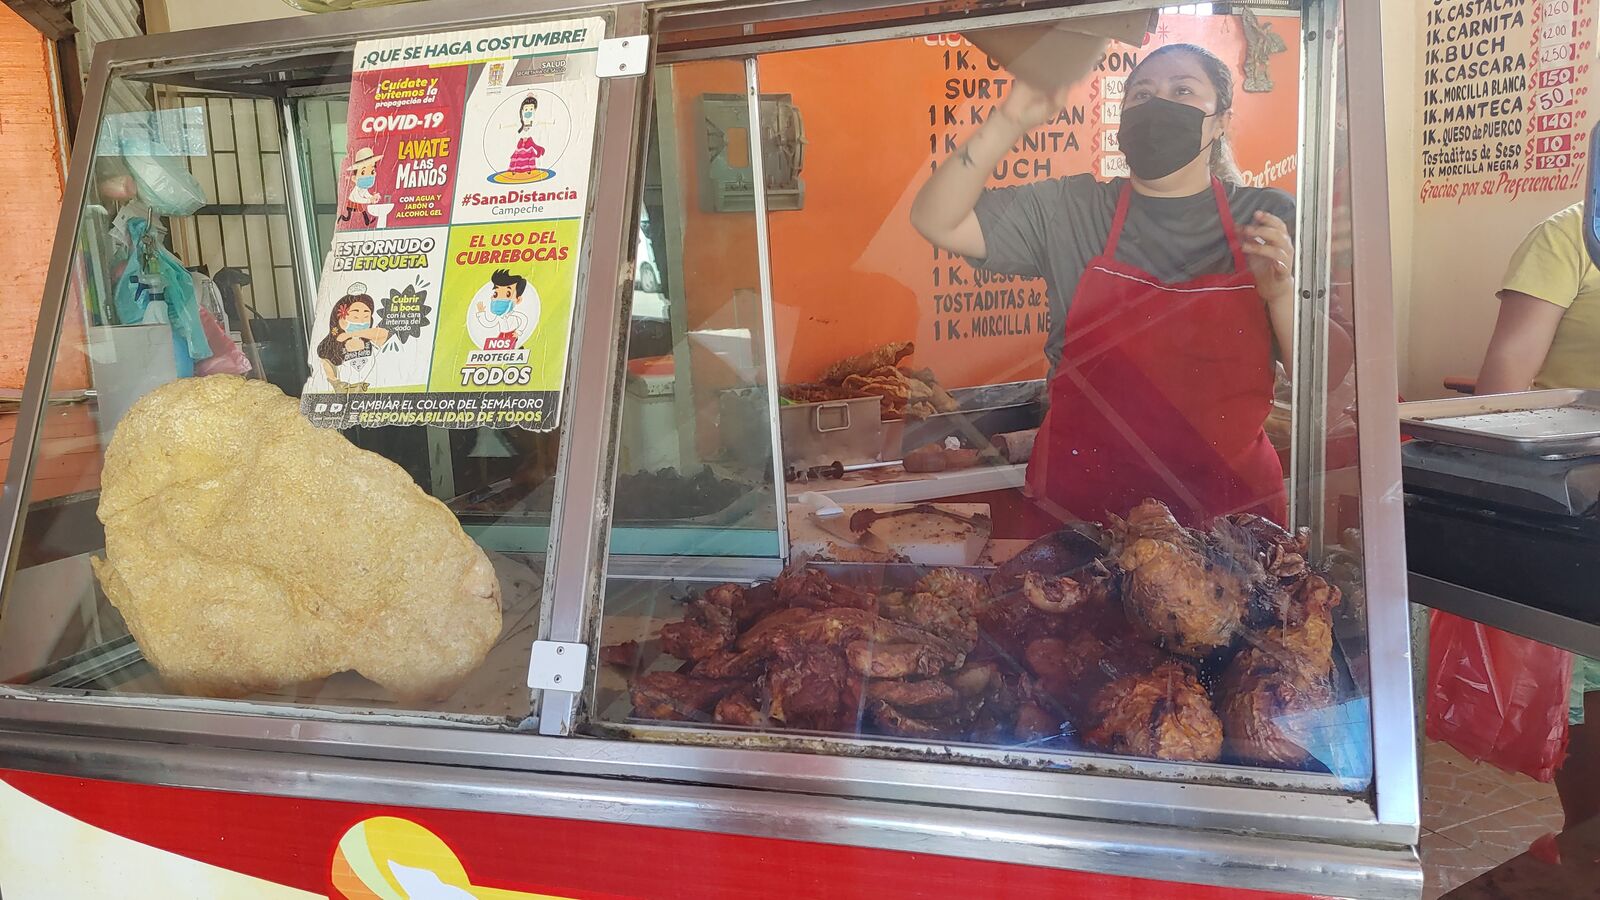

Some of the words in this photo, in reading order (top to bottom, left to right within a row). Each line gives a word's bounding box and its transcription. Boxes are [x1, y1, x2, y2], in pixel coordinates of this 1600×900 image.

[1446, 10, 1524, 42] CARNITA
[360, 48, 402, 69] ¡QUE
[404, 46, 423, 60] SE
[424, 40, 472, 58] HAGA
[476, 28, 587, 52] COSTUMBRE!
[1445, 36, 1505, 63] BUCH
[541, 60, 566, 69] SALUD
[943, 50, 950, 70] 1
[956, 50, 976, 71] K.
[1445, 52, 1526, 83] CASCARA
[374, 88, 424, 101] evitemos
[426, 86, 438, 96] la
[376, 78, 428, 94] ¡Cuídate
[430, 77, 438, 87] y
[1107, 80, 1124, 95] $20
[1444, 80, 1489, 103] MORCILLA
[1491, 74, 1527, 96] BLANCA
[374, 97, 422, 110] propagación
[423, 95, 435, 104] del
[1443, 96, 1523, 122] MANTECA
[361, 111, 444, 133] COVID-19
[928, 105, 936, 126] 1
[944, 104, 964, 126] K.
[1442, 125, 1471, 147] QUESO
[1483, 118, 1522, 139] PUERCO
[930, 133, 937, 153] 1
[1422, 148, 1478, 166] Tostaditas
[1480, 144, 1491, 160] de
[1495, 141, 1522, 159] Seso
[413, 159, 434, 170] LAS
[992, 158, 1051, 180] UCH
[1438, 162, 1484, 178] MORCILLA
[1487, 159, 1519, 172] NEGRA
[395, 164, 447, 189] MANOS
[461, 186, 578, 207] #SanaDistancia
[1420, 177, 1457, 205] Gracias
[1458, 182, 1480, 205] por
[1480, 181, 1495, 196] su
[395, 210, 428, 219] ALCOHOL
[429, 209, 442, 217] GEL
[491, 203, 544, 217] Campeche
[335, 237, 435, 257] ESTORNUDO
[469, 235, 487, 248] EL
[490, 232, 524, 247] USO
[528, 230, 557, 245] DEL
[333, 256, 353, 271] DE
[353, 254, 428, 271] ETIQUETA
[455, 246, 569, 266] CUBREBOCAS
[932, 267, 940, 287] 1
[949, 265, 968, 285] K.
[391, 304, 399, 312] la
[400, 303, 420, 312] boca
[392, 295, 419, 304] Cubrir
[934, 288, 1025, 314] TOSTADITAS
[1028, 288, 1041, 307] de
[934, 320, 940, 341] 1
[948, 319, 968, 340] K.
[972, 313, 1031, 338] MORCILLA
[489, 339, 511, 349] NOS
[471, 352, 514, 363] PROTEGE
[516, 352, 523, 362] A
[461, 367, 532, 386] TODOS
[351, 399, 400, 411] CAMBIAR
[401, 400, 413, 410] EL
[416, 399, 455, 410] COLOR
[457, 399, 478, 410] DEL
[359, 411, 474, 424] RESPONSABILIDAD
[476, 411, 493, 422] DE
[496, 411, 542, 422] TODOS
